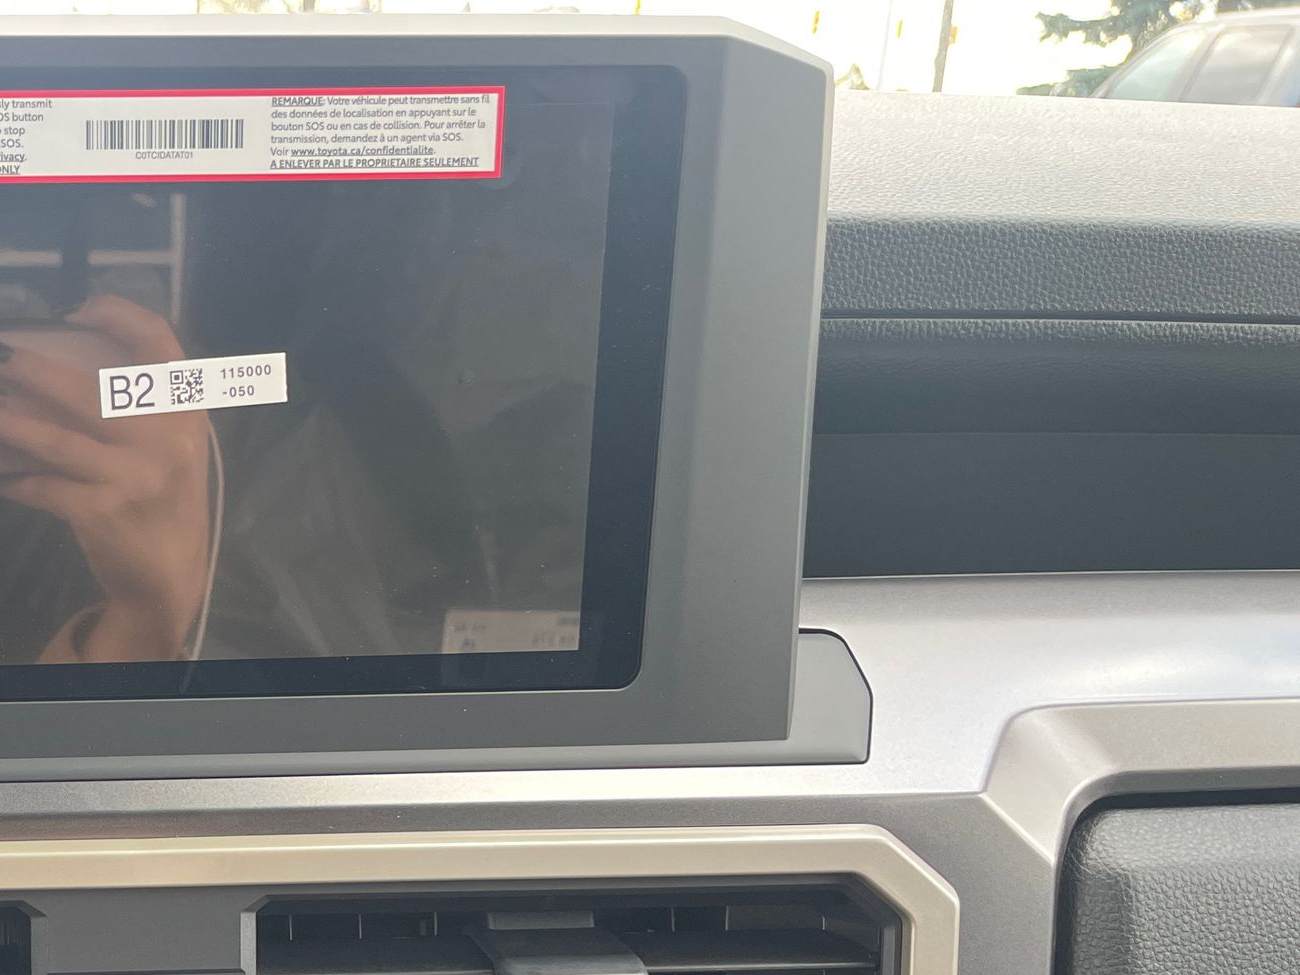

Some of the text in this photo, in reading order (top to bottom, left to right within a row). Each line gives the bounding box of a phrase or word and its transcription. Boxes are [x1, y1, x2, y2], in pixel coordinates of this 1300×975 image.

[12, 99, 53, 109] transmit
[272, 97, 326, 107] REMARQUE:
[326, 97, 350, 106] Votre
[352, 96, 386, 105] véhicule
[388, 96, 409, 106] peut
[410, 96, 459, 104] transmettre
[481, 94, 490, 104] fil
[12, 112, 44, 122] button
[271, 109, 288, 118] des
[289, 109, 328, 118] données
[330, 108, 342, 118] de
[343, 108, 394, 118] localisation
[408, 108, 451, 119] appuyant
[468, 108, 476, 116] le
[4, 126, 26, 136] stop
[271, 122, 304, 131] bouton
[306, 122, 324, 130] SOS
[369, 121, 382, 130] de
[383, 120, 422, 130] collision.
[424, 120, 444, 130] Pour
[446, 120, 478, 129] arrêter
[478, 120, 486, 128] la
[0, 139, 24, 148] SOS.
[270, 134, 329, 144] transmission,
[330, 134, 378, 143] demandez
[380, 134, 386, 142] à
[400, 134, 426, 144] agent
[428, 132, 440, 142] via
[442, 132, 464, 142] SOS.
[270, 146, 436, 157] Voir www.toyota.ca/confidentialite.
[270, 158, 480, 170] A ENLEVER PAR LE PROPRIETAIRE SEULEMENT
[108, 364, 272, 411] B2 115000
[222, 384, 255, 398] -050
